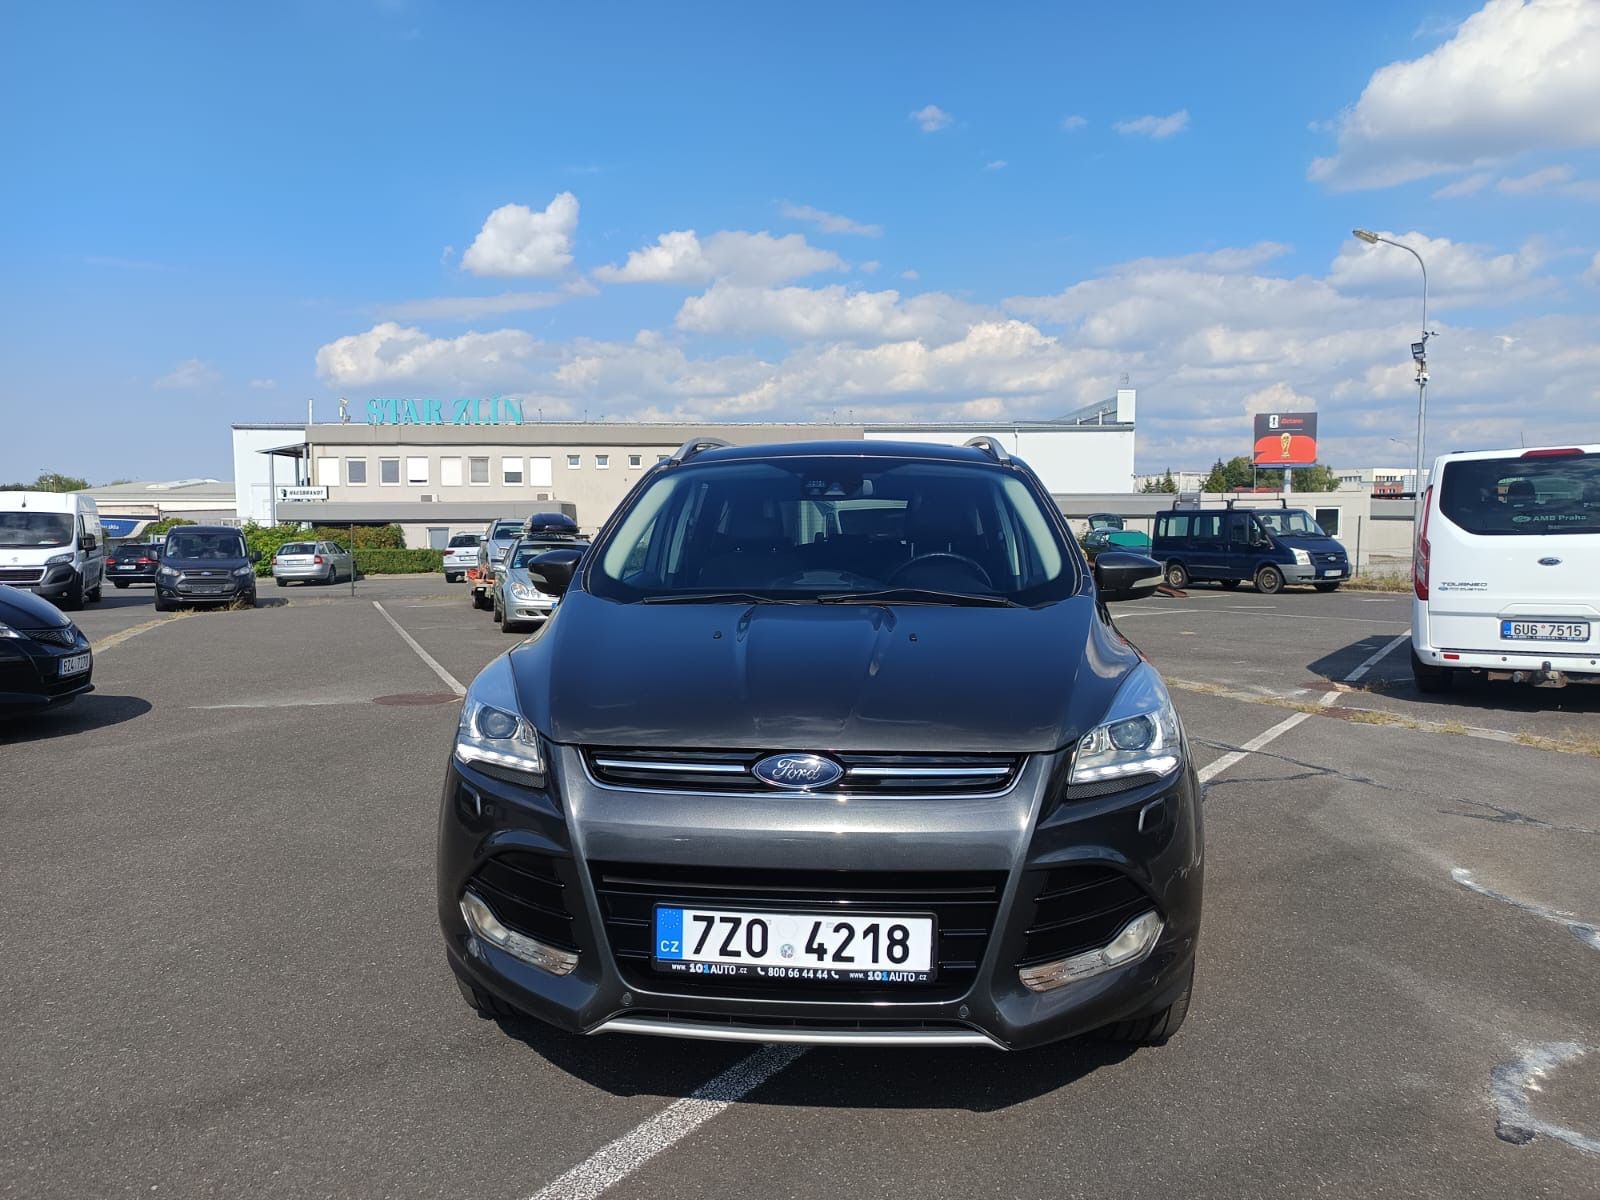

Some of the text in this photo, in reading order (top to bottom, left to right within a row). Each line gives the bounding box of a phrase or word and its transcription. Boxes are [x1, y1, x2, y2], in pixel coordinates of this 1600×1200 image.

[367, 395, 524, 425] STAR ZLÍN
[1513, 624, 1538, 635] 6U6
[1548, 625, 1582, 637] 7515
[772, 758, 822, 780] Ford
[660, 940, 679, 953] CZ
[692, 914, 911, 965] 7Z0 4218
[689, 962, 737, 975] 101AUTO
[768, 967, 786, 978] 800
[788, 968, 800, 978] 66
[802, 968, 814, 979] 44
[816, 969, 828, 980] 44
[867, 971, 916, 982] 101AUTO
